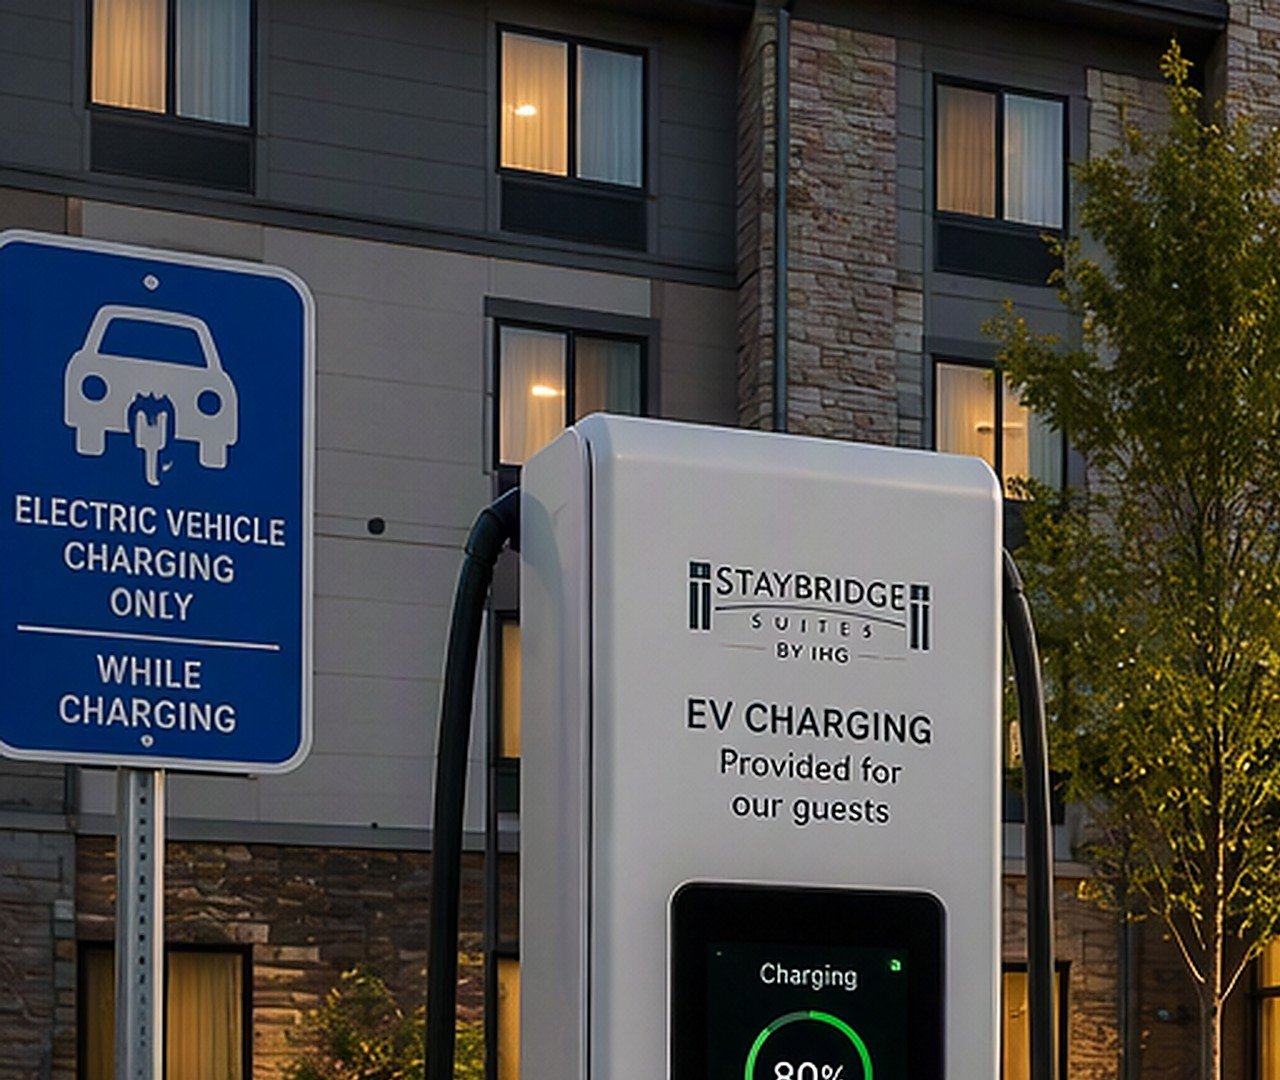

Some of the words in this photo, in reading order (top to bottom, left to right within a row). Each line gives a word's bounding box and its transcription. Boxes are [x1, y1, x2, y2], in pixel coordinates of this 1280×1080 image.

[16, 494, 157, 534] ELECTRIC
[167, 508, 286, 547] VEHICLE
[64, 541, 235, 583] CHARGING
[110, 587, 194, 621] ONLY
[716, 566, 906, 611] STAYBRIDGE
[751, 613, 872, 639] SUITES
[777, 641, 803, 659] BY
[812, 646, 849, 664] IHG
[96, 654, 202, 689] WHILE
[59, 694, 236, 733] CHARGING
[687, 698, 733, 731] EV
[745, 702, 931, 745] CHARGING
[721, 748, 851, 781] Provided
[861, 756, 902, 784] for
[732, 796, 784, 818] our
[792, 799, 889, 826] guests
[760, 962, 858, 991] Charging
